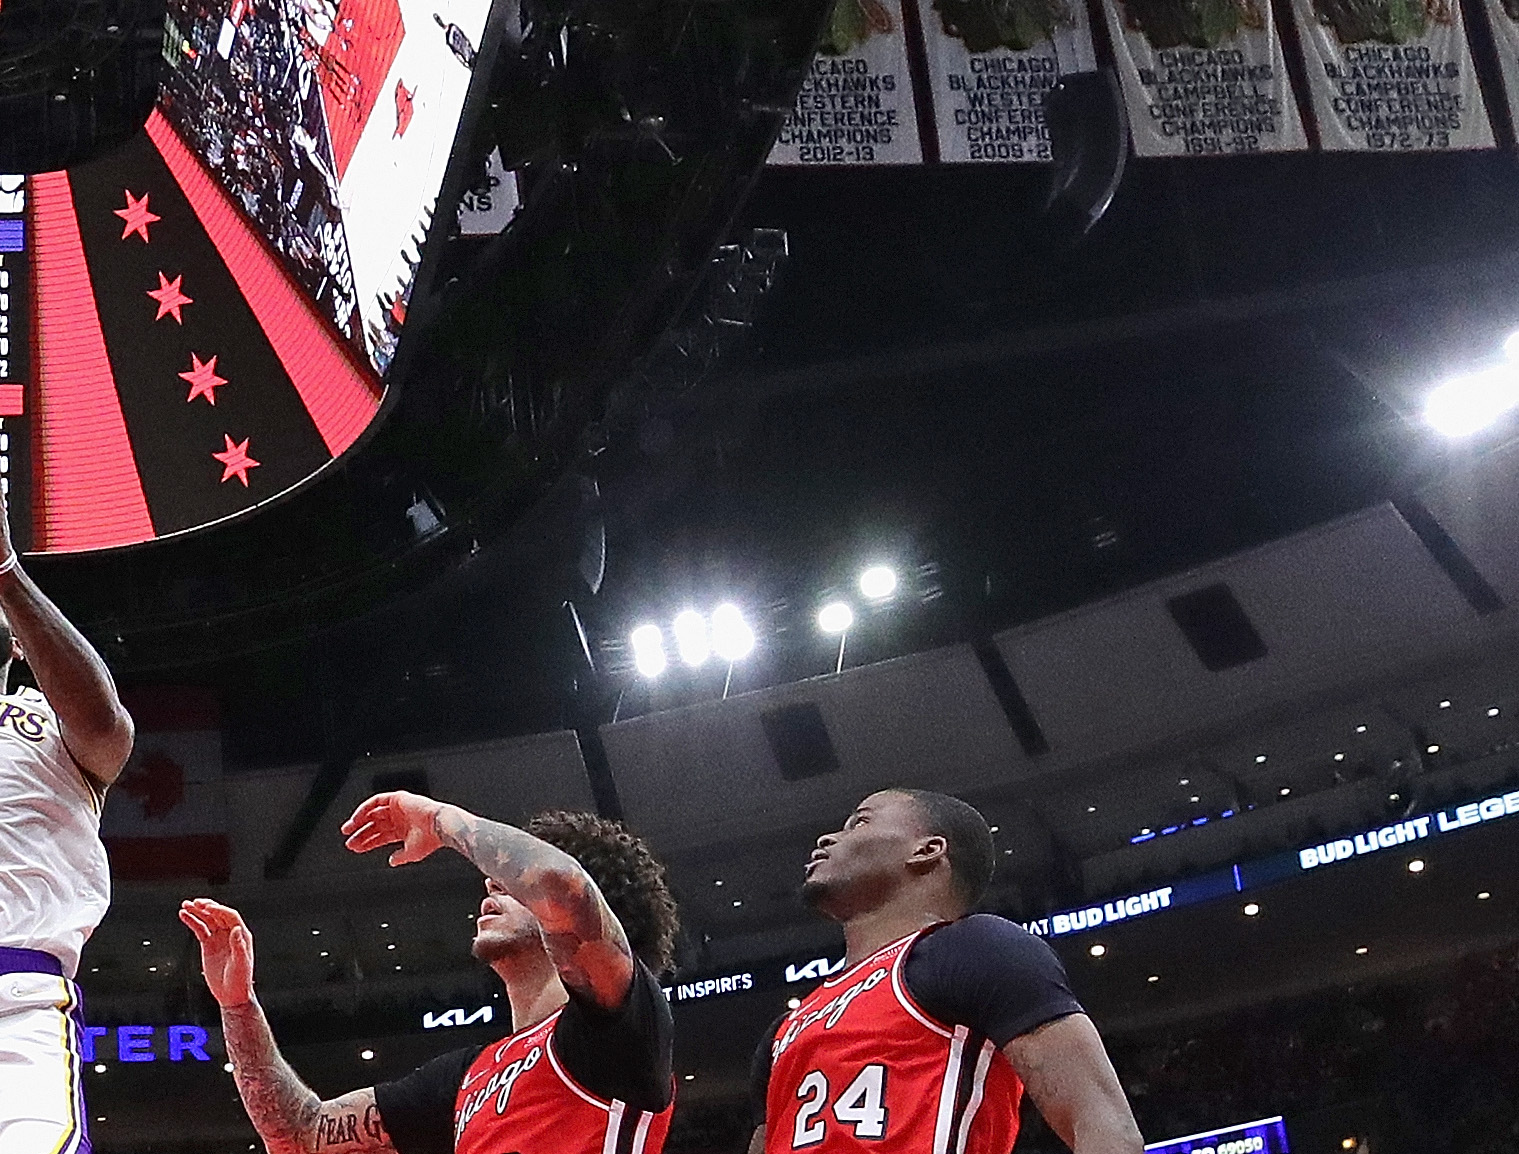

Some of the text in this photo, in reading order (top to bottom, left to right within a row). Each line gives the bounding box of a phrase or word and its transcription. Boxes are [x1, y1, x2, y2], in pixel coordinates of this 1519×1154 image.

[970, 57, 1054, 73] CHICAGO
[799, 95, 881, 110] ESTERN
[954, 108, 1046, 125] CONFERE
[799, 145, 875, 162] 2012-13
[1299, 791, 1519, 870] BUD LIGHT LEGE
[1052, 907, 1104, 934] BUD
[1104, 886, 1173, 922] LIGHT
[423, 1005, 493, 1029] KIA
[82, 1024, 211, 1062] TER
[792, 1063, 888, 1150] 24
